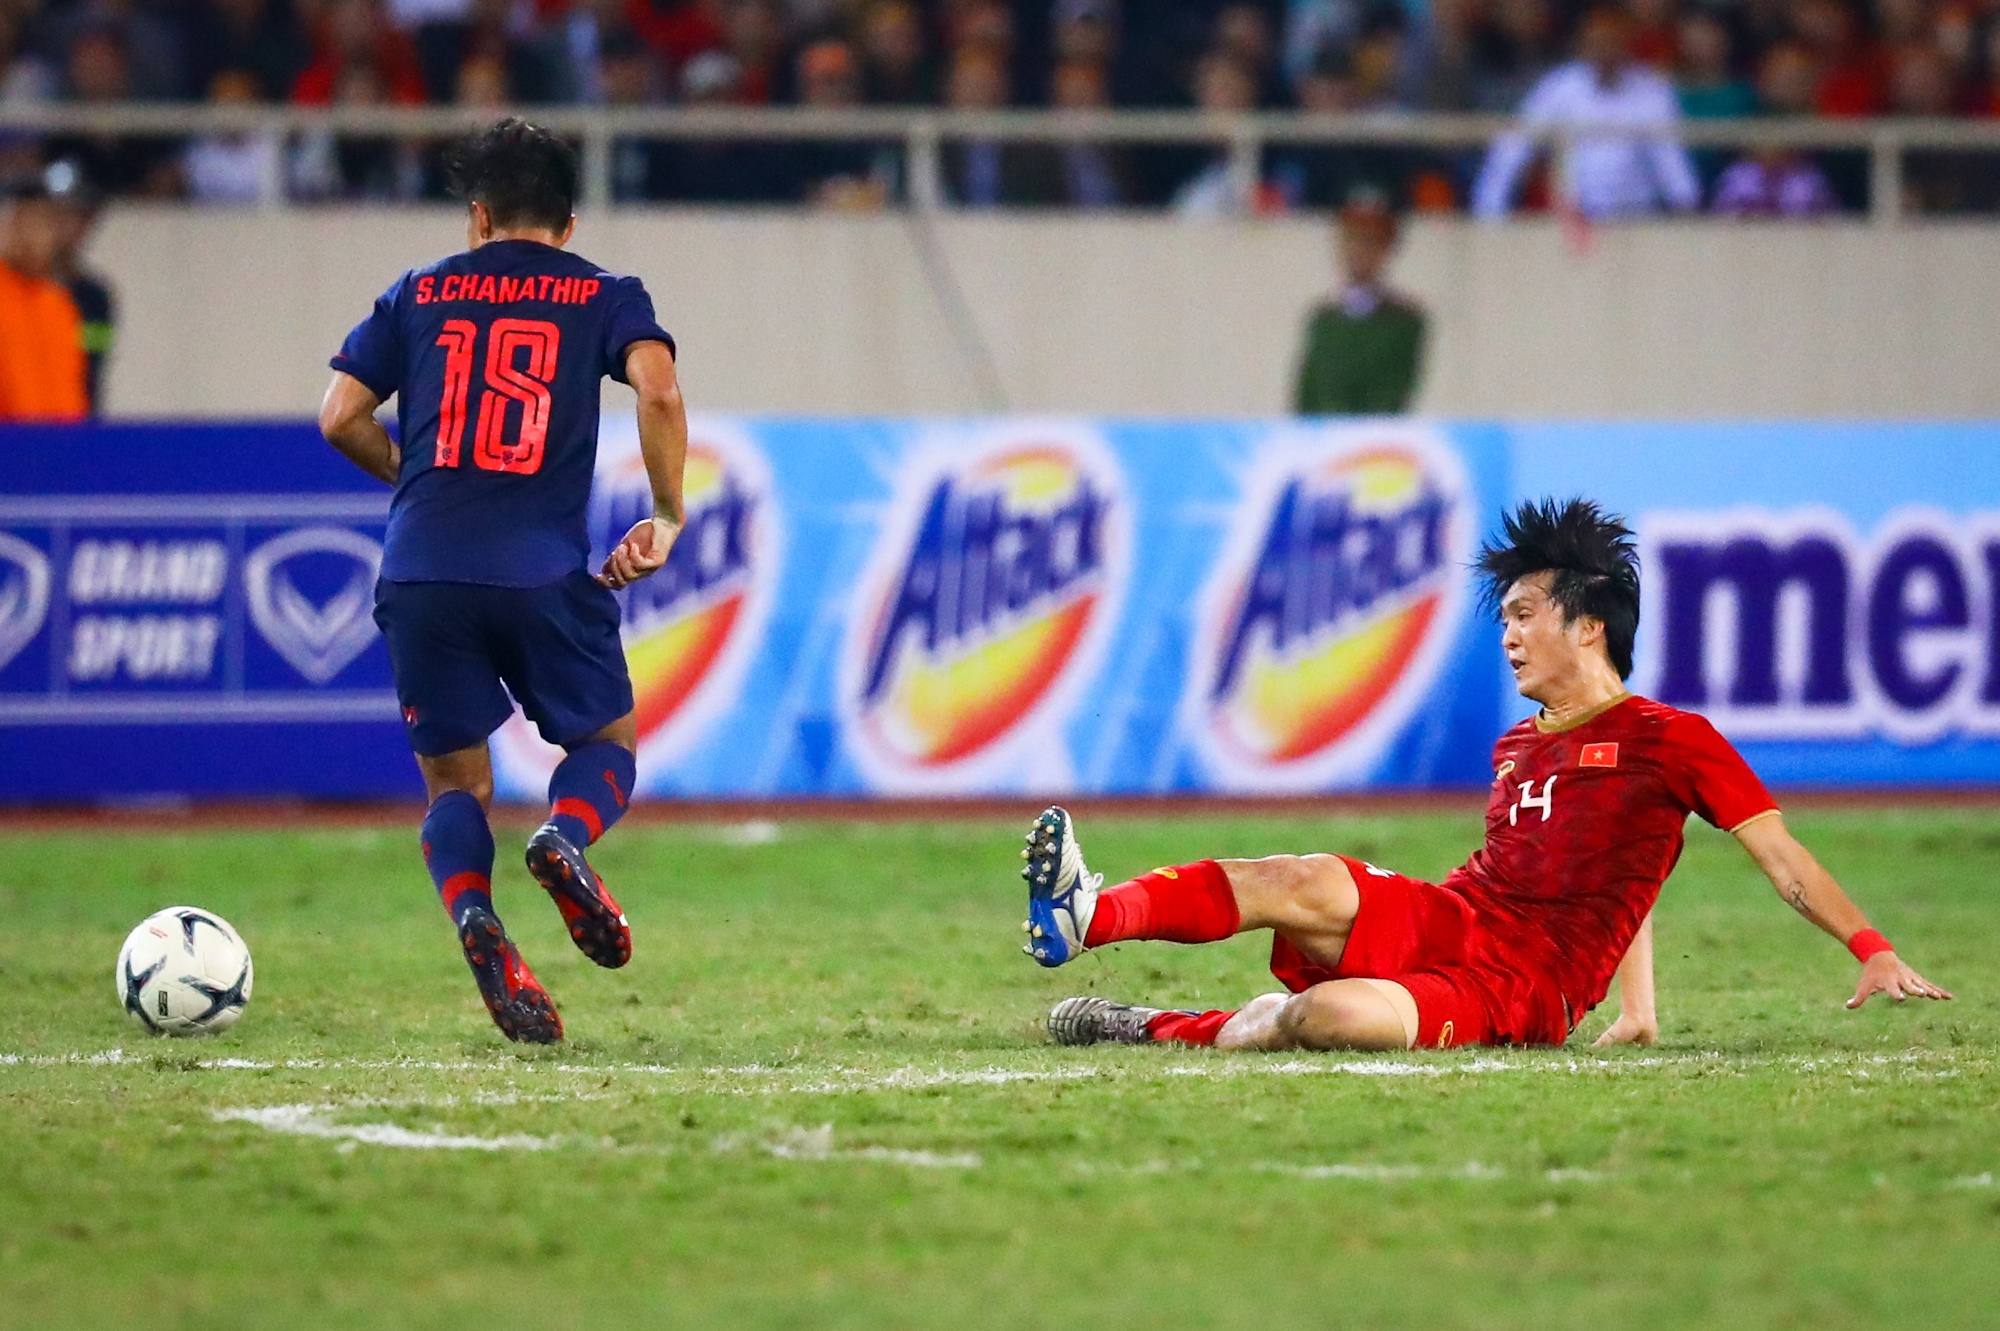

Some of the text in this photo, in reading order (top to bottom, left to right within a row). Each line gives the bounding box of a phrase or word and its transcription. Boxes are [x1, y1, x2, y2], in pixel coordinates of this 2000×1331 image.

[416, 274, 601, 305] S.CHANATHIP
[433, 318, 561, 476] 18
[69, 614, 220, 681] SPORT
[70, 539, 228, 604] GRAND
[864, 474, 1111, 702] Attack
[1211, 474, 1455, 704] Attack
[1659, 532, 2000, 710] me
